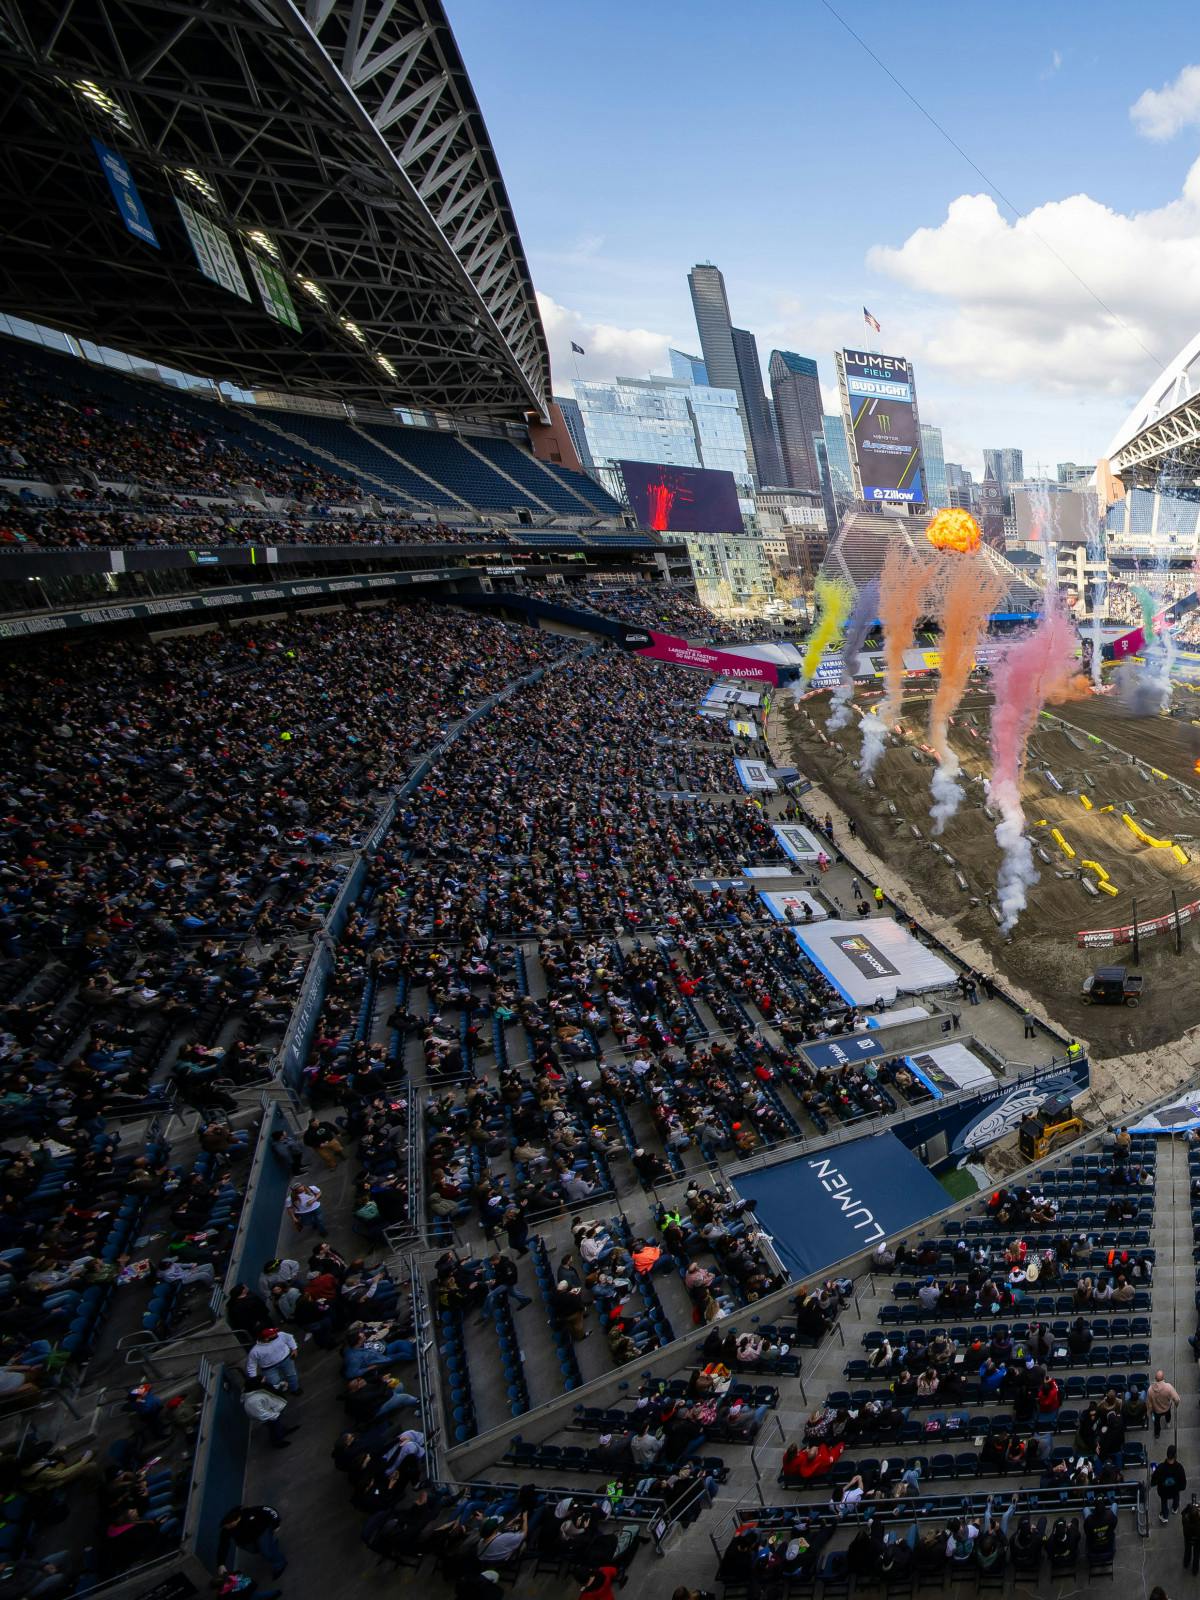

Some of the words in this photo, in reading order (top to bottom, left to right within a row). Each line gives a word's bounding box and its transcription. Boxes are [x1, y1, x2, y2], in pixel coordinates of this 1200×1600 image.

[844, 352, 907, 372] LUMEN
[864, 367, 891, 378] FIELD
[851, 380, 876, 392] BUD
[876, 382, 909, 397] LIGHT
[883, 489, 914, 500] Zillow
[733, 667, 763, 677] Mobile
[860, 952, 892, 974] peacock
[978, 1086, 1014, 1104] UYALLUP
[1013, 1079, 1033, 1093] TRIBE
[810, 1159, 886, 1243] LUMEN
